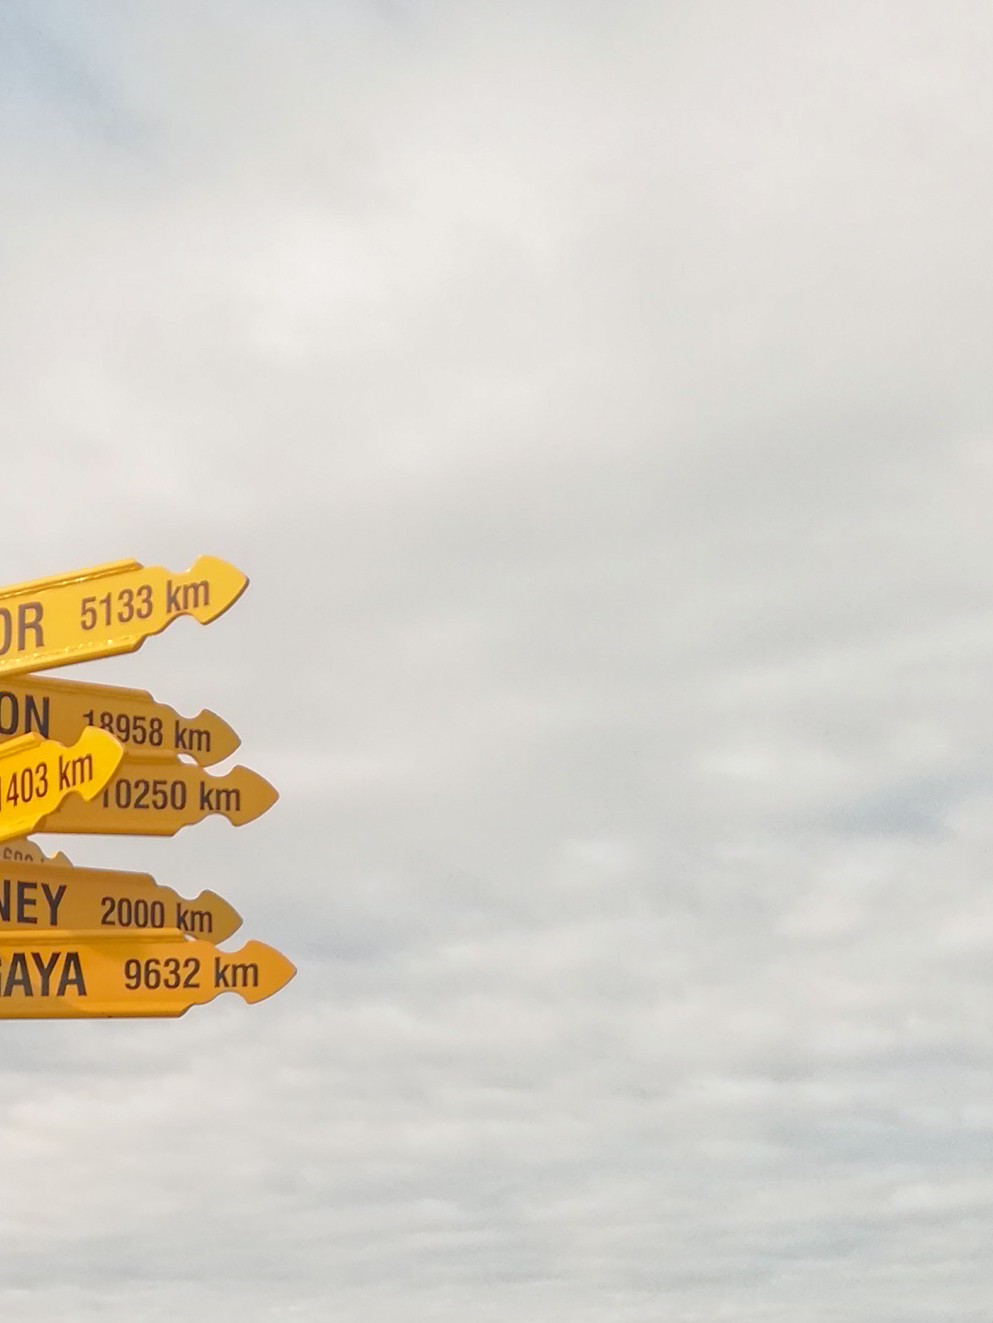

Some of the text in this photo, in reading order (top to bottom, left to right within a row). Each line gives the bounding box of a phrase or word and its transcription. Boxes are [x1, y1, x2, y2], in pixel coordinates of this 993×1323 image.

[80, 584, 153, 631] 5133
[166, 578, 210, 615] km
[83, 710, 163, 746] 18958
[175, 720, 211, 752] km
[58, 754, 93, 791] km
[199, 781, 240, 811] km
[101, 897, 164, 929] 2000
[176, 903, 213, 933] km
[124, 958, 200, 990] 9632
[214, 957, 259, 988] km
